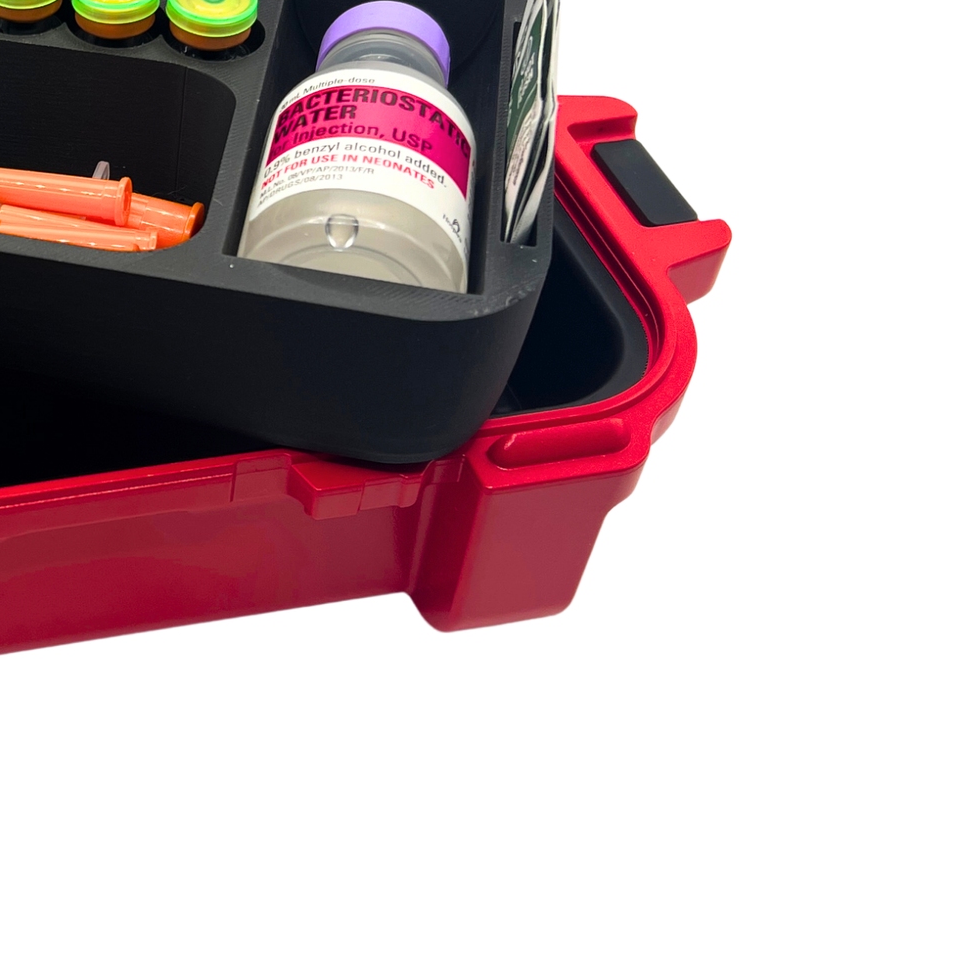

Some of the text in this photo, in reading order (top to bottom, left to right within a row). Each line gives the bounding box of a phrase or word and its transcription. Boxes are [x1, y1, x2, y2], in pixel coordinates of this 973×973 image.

[303, 76, 375, 94] Multiple-dose
[268, 121, 433, 161] for Injection, USP
[273, 104, 358, 144] WATER
[276, 88, 469, 159] BACTERIOSTATIC
[260, 153, 435, 191] NOT FOR USE IN NEONATES
[263, 141, 448, 188] 0.9% benzyl alcohol added.
